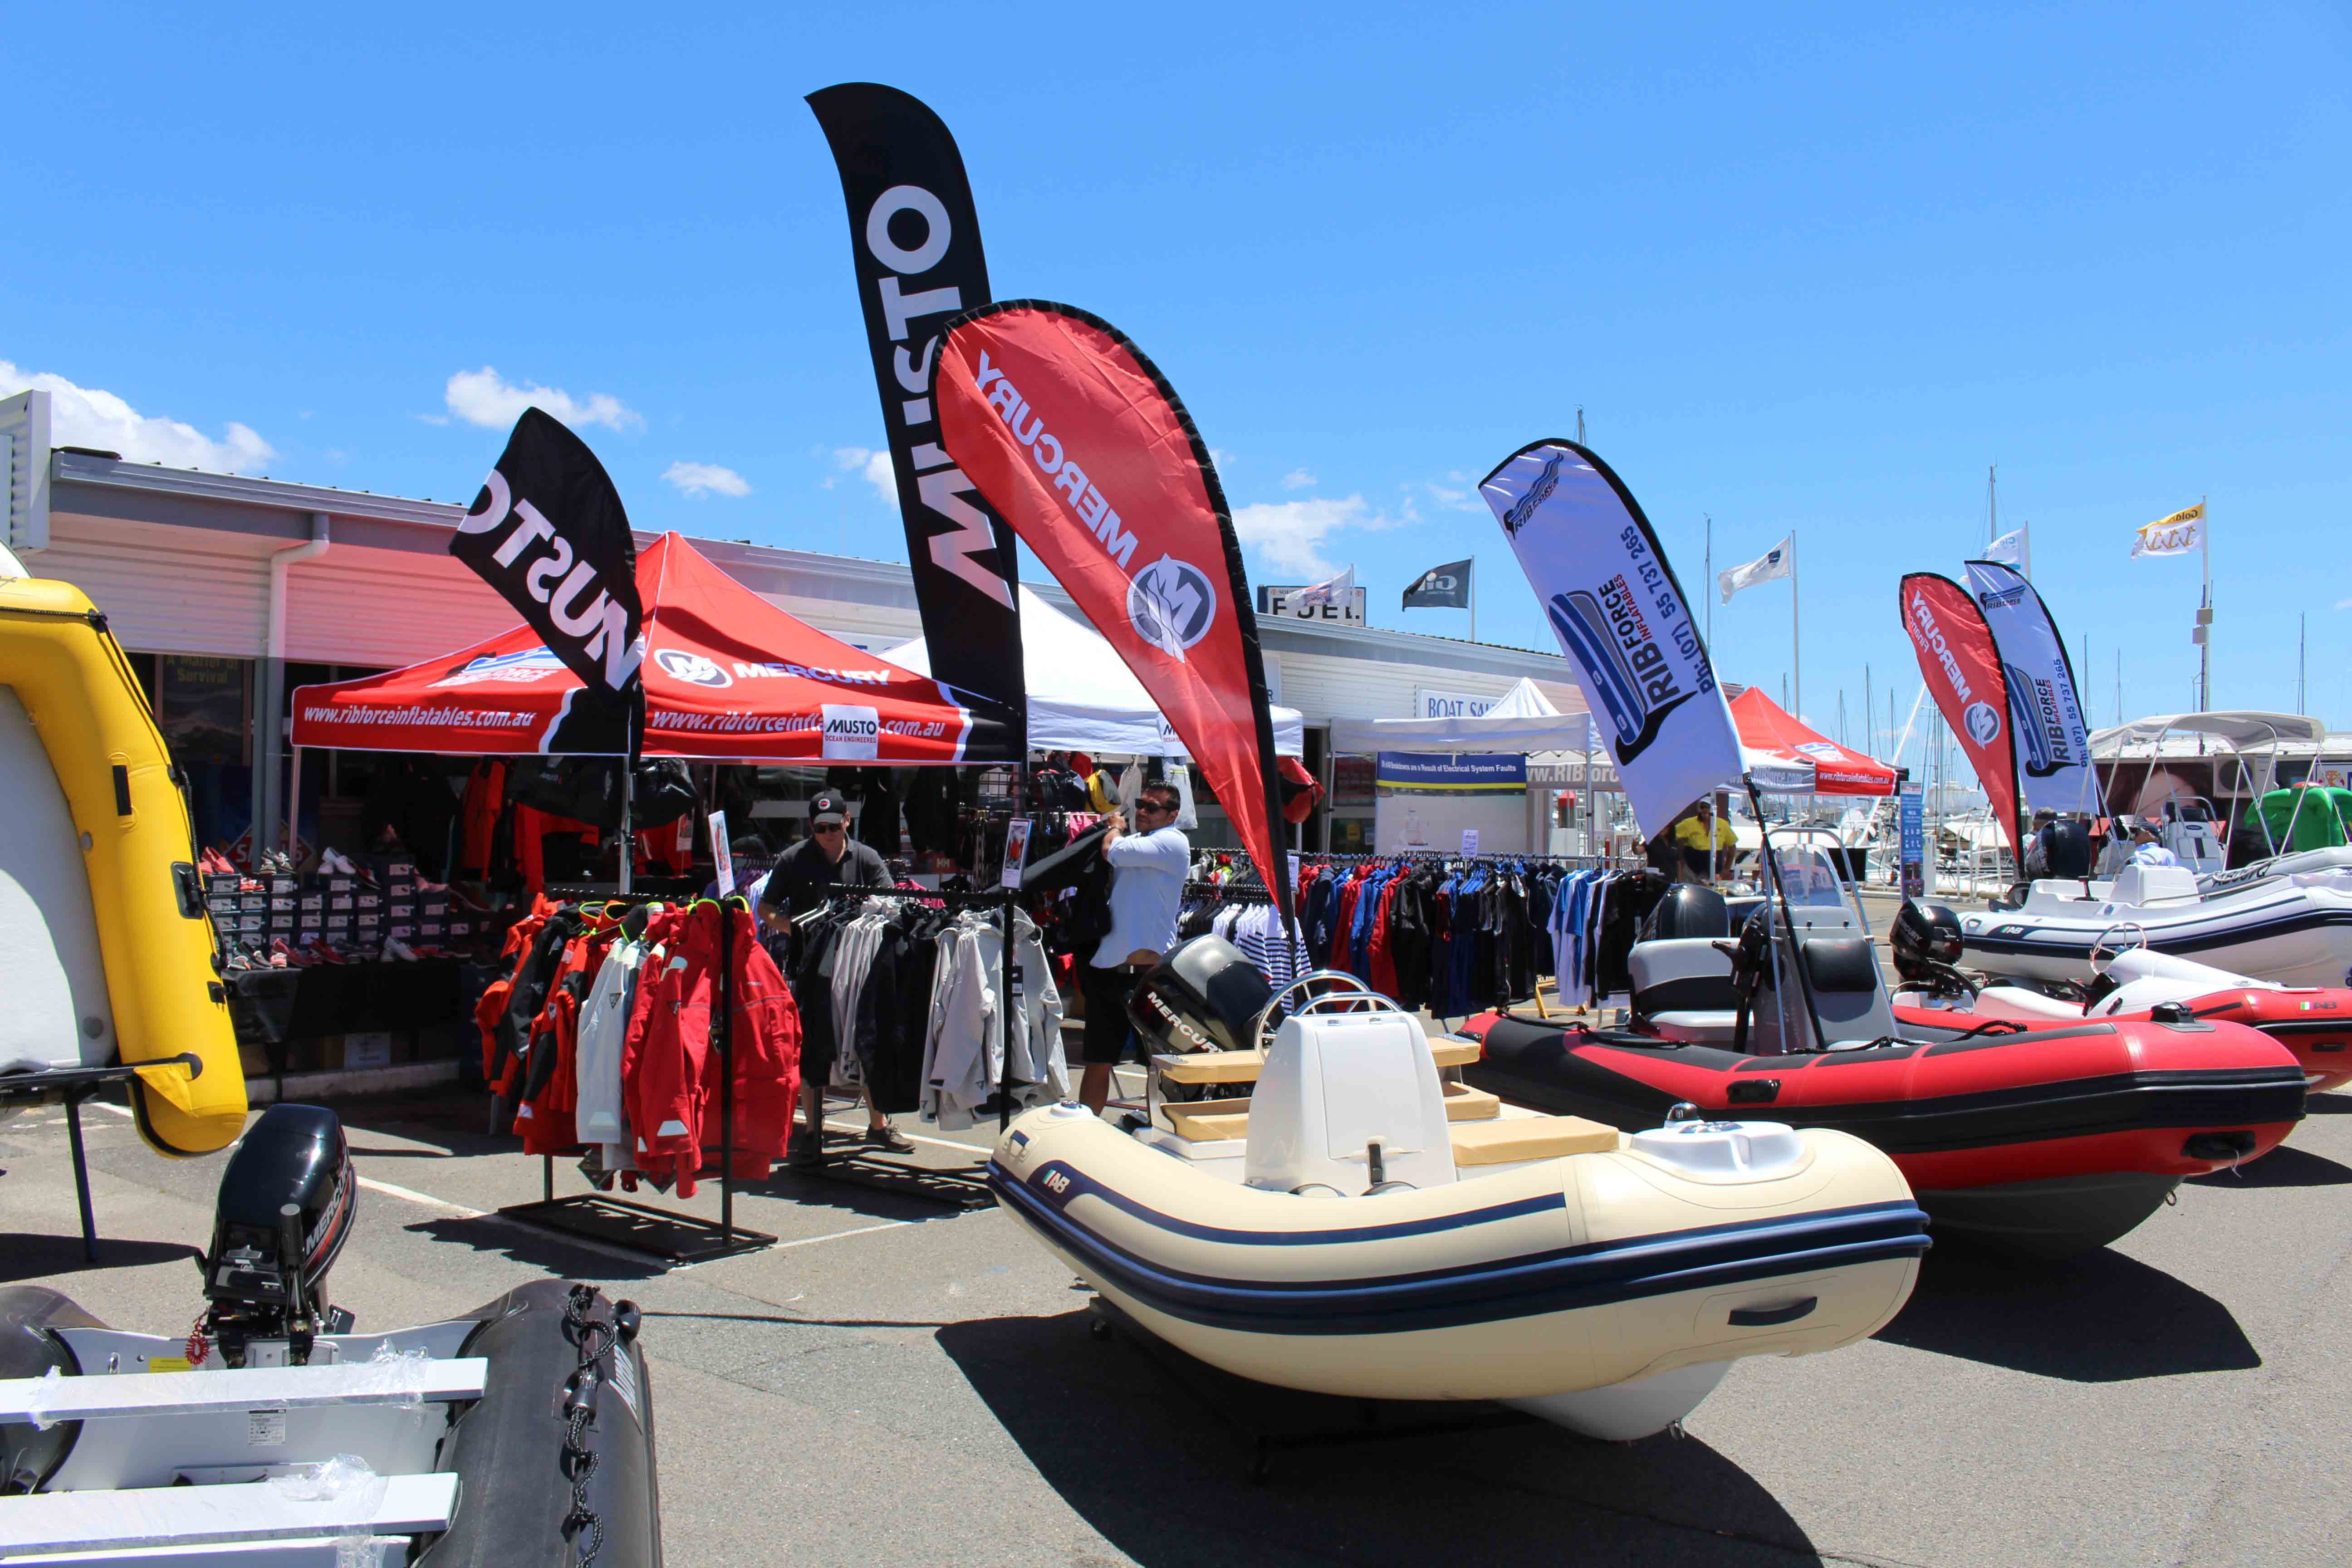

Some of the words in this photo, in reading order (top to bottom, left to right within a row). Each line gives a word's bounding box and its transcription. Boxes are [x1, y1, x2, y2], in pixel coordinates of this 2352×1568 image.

[1620, 526, 1646, 560] 265
[1637, 561, 1663, 595] 737
[1613, 573, 1653, 642] INFLATABLES
[1655, 592, 1676, 619] 55
[1671, 619, 1700, 661] (07)
[733, 662, 890, 686] MERCURY
[2054, 659, 2066, 679] 265
[2045, 679, 2061, 725] INFLATABLES
[2059, 684, 2072, 702] 737
[304, 705, 537, 727] www.ribforceinflatables.com.au
[1429, 698, 1464, 718] BOAT
[2067, 706, 2077, 719] 55
[652, 711, 946, 736] www.ribforceinfla.com.au
[826, 719, 877, 735] MUSTO
[2072, 726, 2086, 746] (07)
[1471, 765, 1494, 774] System
[1148, 991, 1223, 1053] MERCUR
